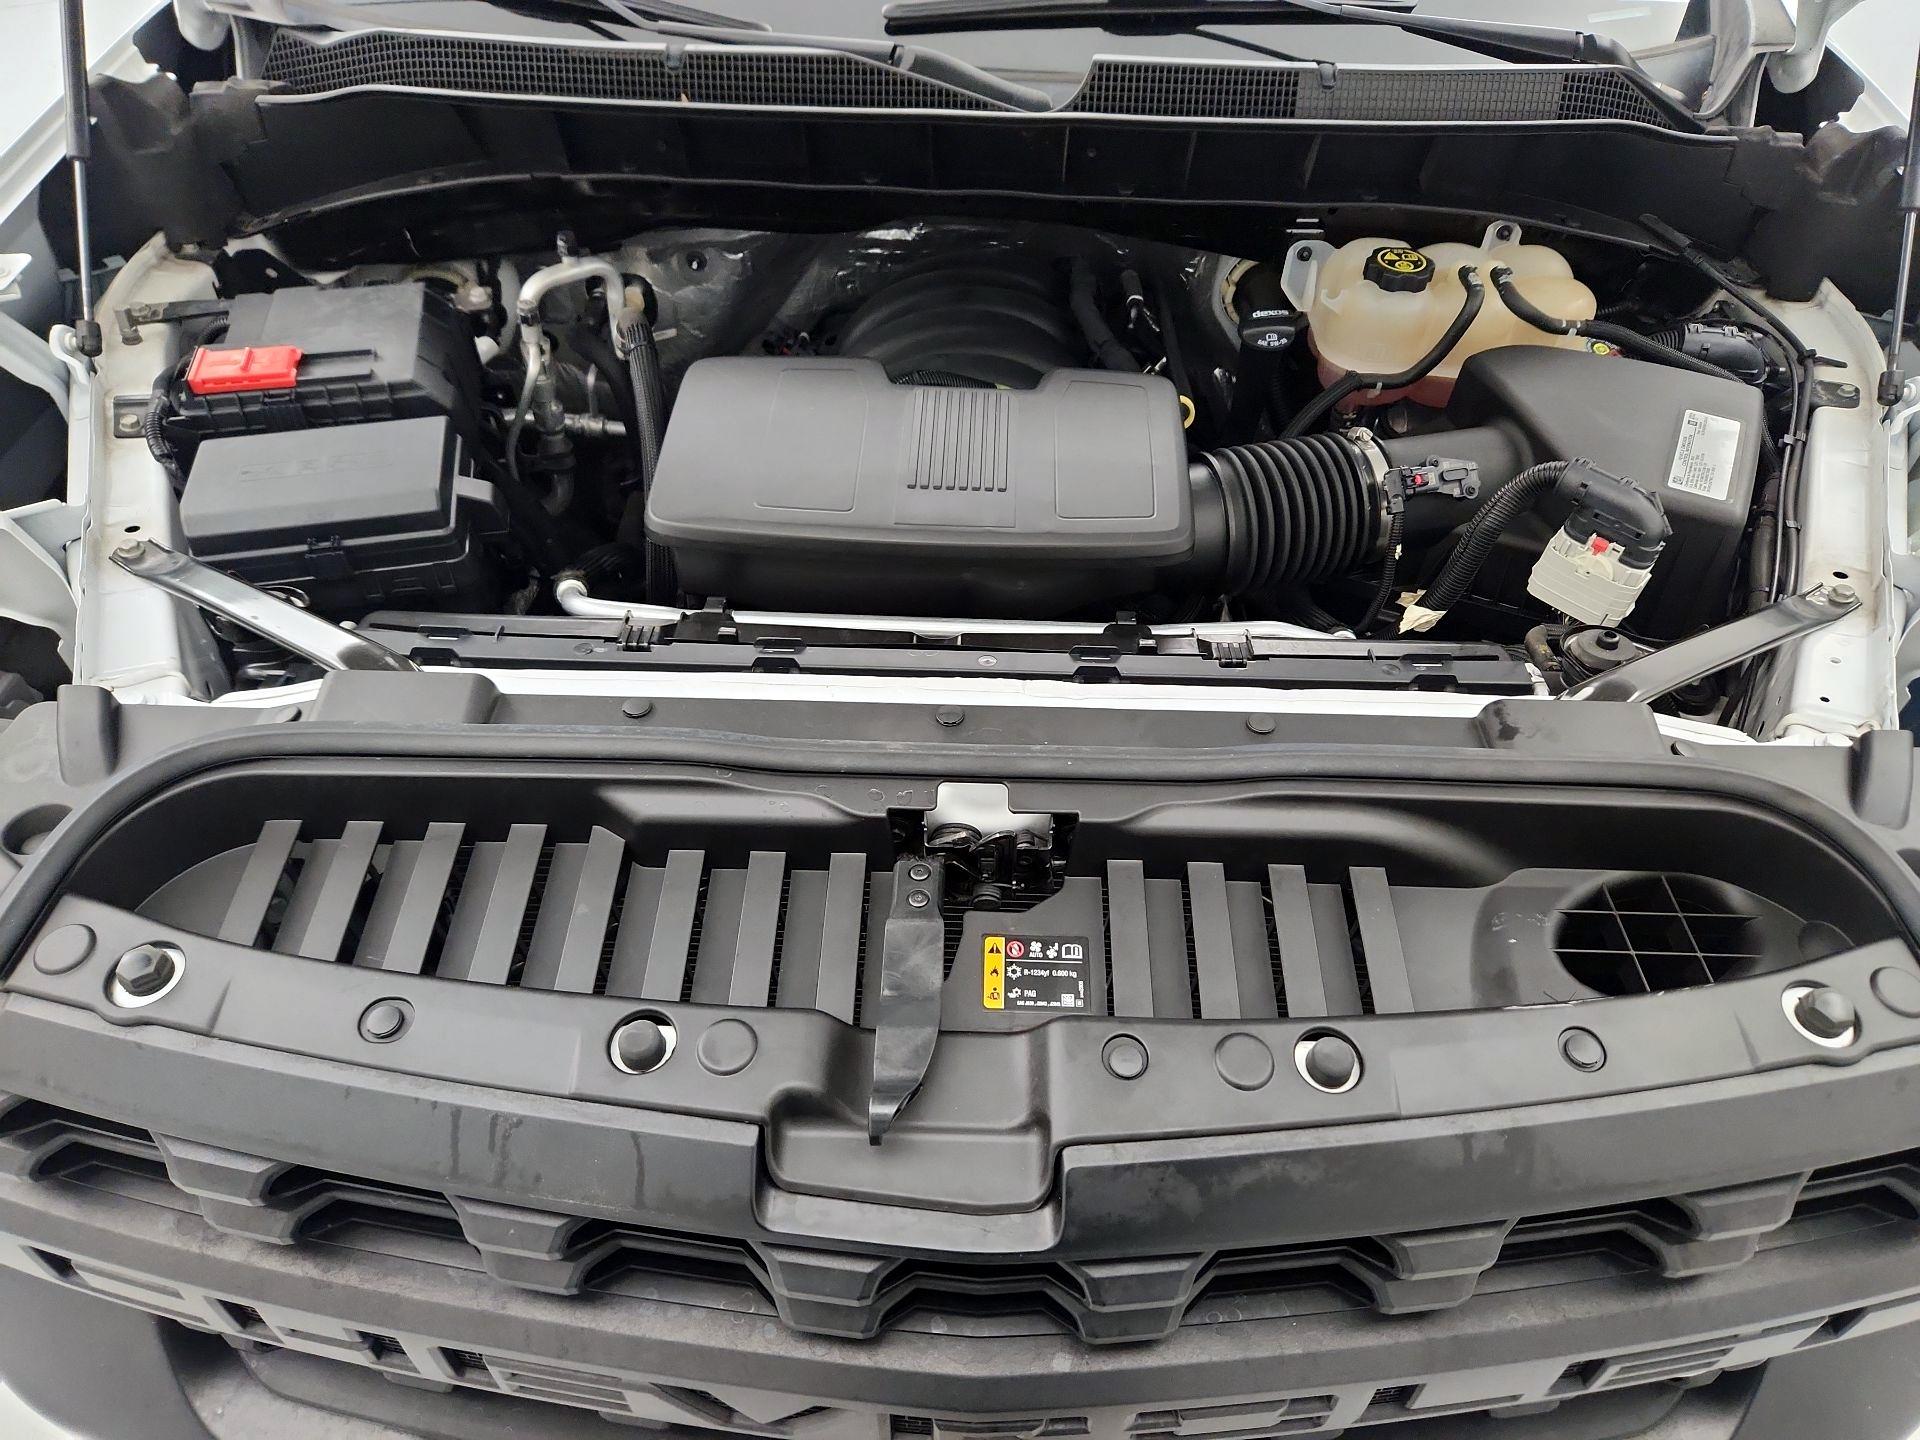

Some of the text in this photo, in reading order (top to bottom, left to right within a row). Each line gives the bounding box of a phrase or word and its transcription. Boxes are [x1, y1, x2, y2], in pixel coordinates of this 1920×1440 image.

[1252, 310, 1289, 318] dexos
[1069, 970, 1078, 979] kg
[1023, 989, 1037, 998] PAG
